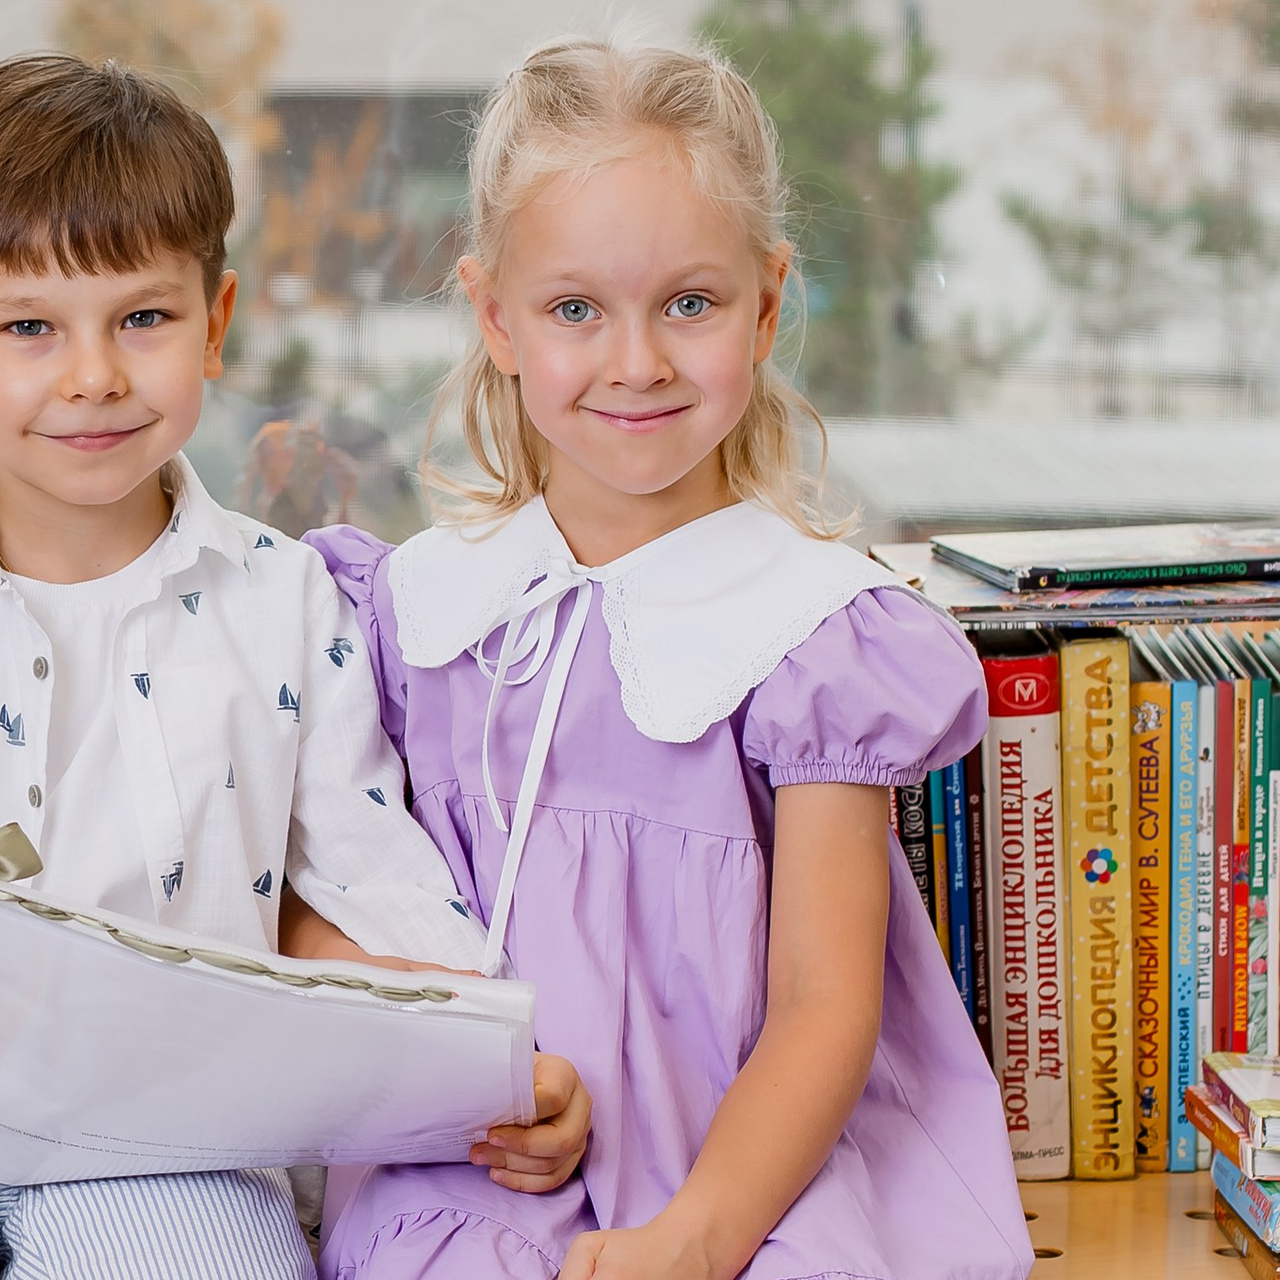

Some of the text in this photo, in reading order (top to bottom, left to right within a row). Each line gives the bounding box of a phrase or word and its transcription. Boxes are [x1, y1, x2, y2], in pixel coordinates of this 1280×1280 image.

[1180, 780, 1192, 810] ЕГО
[1180, 814, 1192, 826] И
[1180, 830, 1193, 872] ГЕНА
[1197, 851, 1212, 916] ДЕРЕВНЕ
[1252, 841, 1266, 888] Птицы
[999, 739, 1031, 1134] БОЛЬШАЯ ЭНЦИКЛОПЕДИЯ
[1032, 787, 1063, 1081] ДЛЯ ДОШКОЛЬНИКА
[1083, 654, 1122, 1172] ЭНЦИКЛОПЕДИЯ ДЕТСТВА
[1134, 736, 1160, 1079] СКАЗОЧНЫЙ МИР В. СУТЕЕВА
[1179, 876, 1194, 966] КРОКОДИЛ
[1218, 844, 1230, 957] СТИХИ ДЛЯ ДЕТЕЙ
[1197, 942, 1212, 1000] ПТИЦЫ
[1234, 904, 1247, 1032] МОРЯ И ОКЕАНЫ
